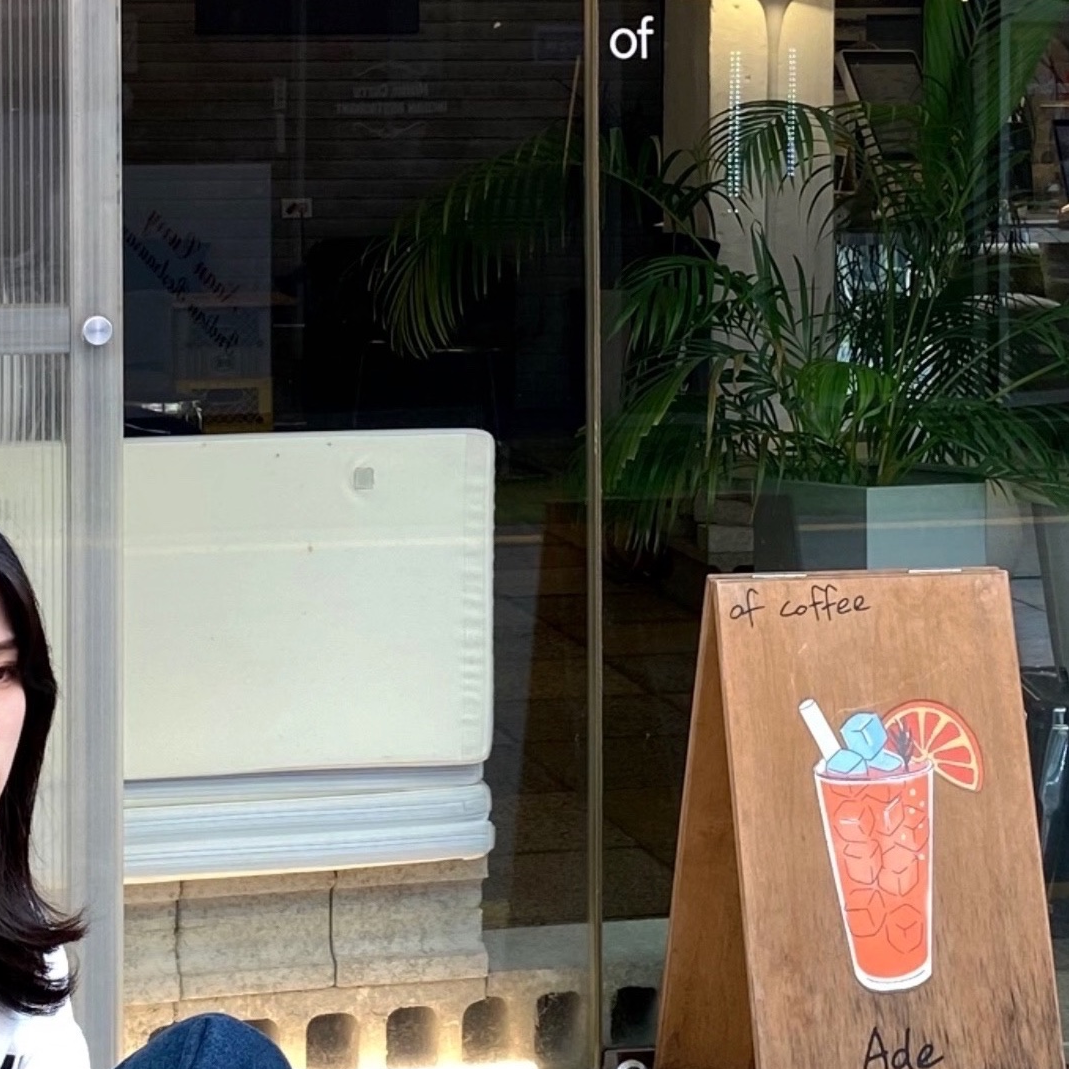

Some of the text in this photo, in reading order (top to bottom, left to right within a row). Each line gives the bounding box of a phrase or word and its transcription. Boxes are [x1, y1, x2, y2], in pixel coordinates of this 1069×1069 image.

[609, 15, 655, 60] of
[730, 585, 871, 627] of coffee
